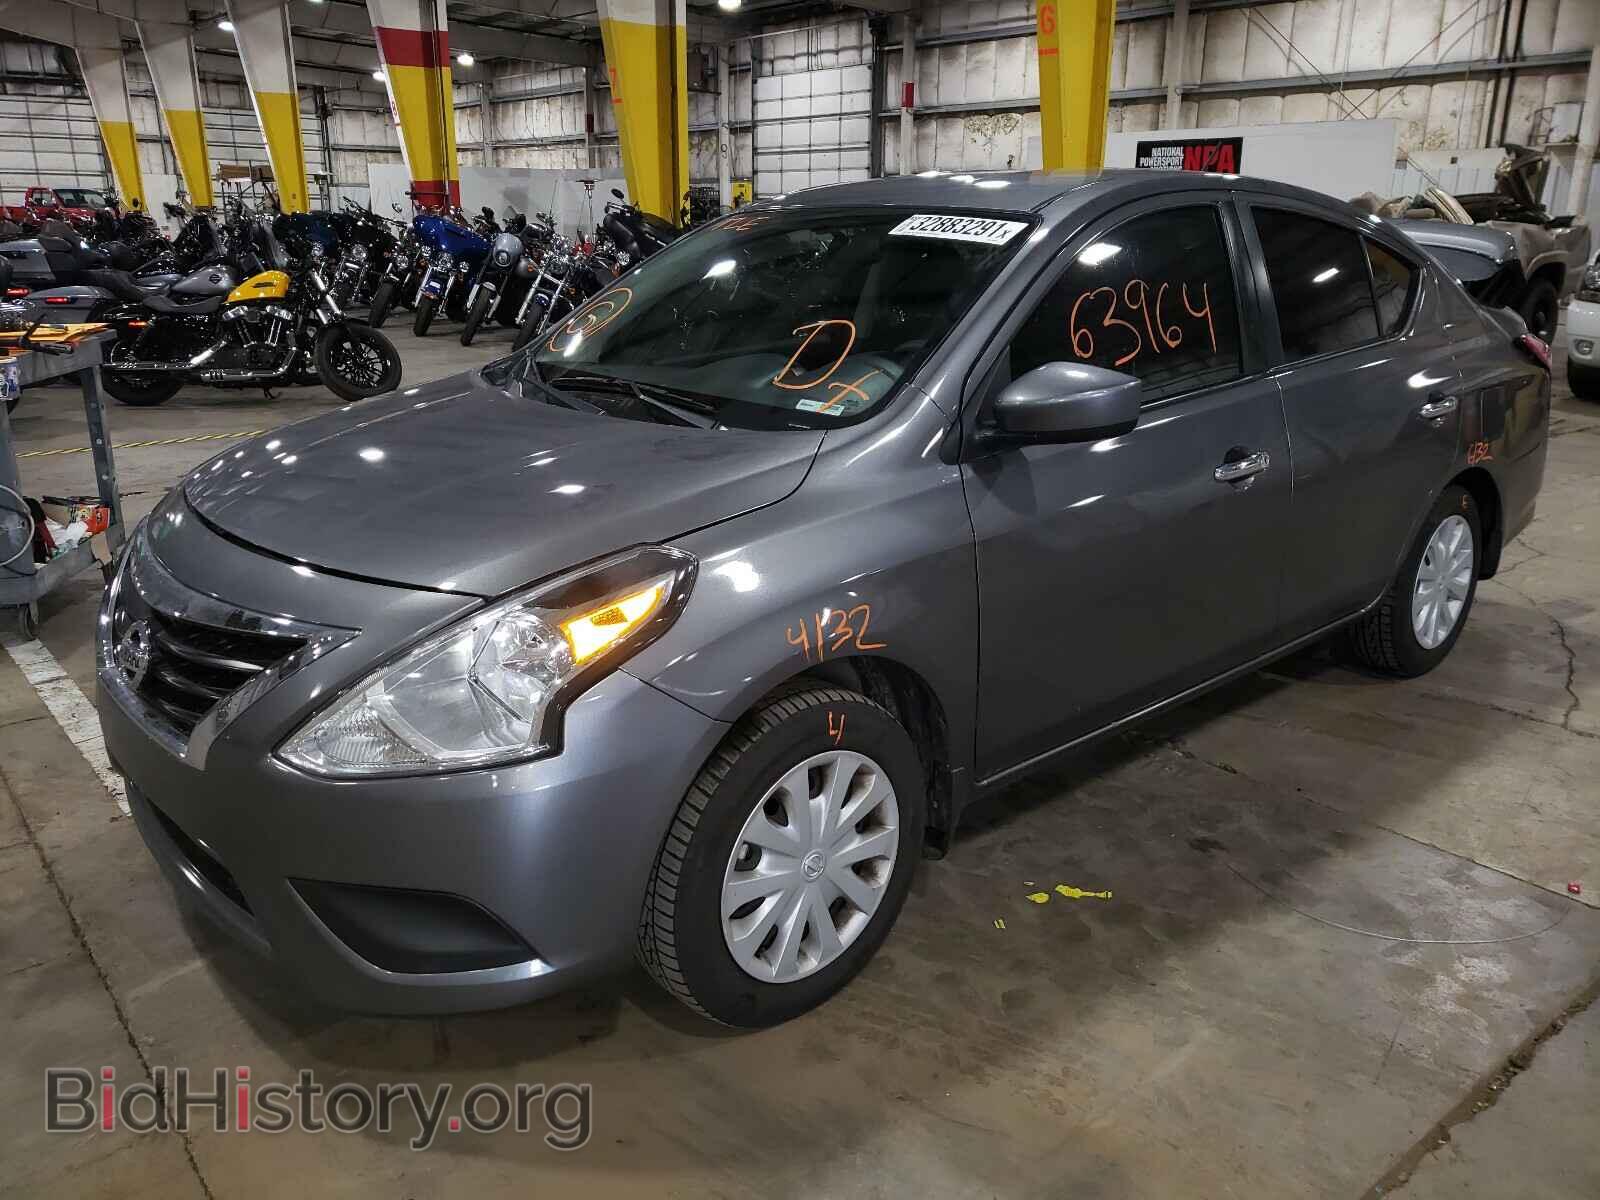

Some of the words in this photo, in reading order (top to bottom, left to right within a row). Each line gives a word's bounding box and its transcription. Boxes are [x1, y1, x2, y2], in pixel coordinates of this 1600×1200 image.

[1039, 3, 1057, 37] 6
[1140, 157, 1184, 167] POWERSPORT
[1151, 146, 1184, 157] NATIONAL
[1184, 144, 1235, 174] NPA
[1071, 279, 1216, 366] 63964
